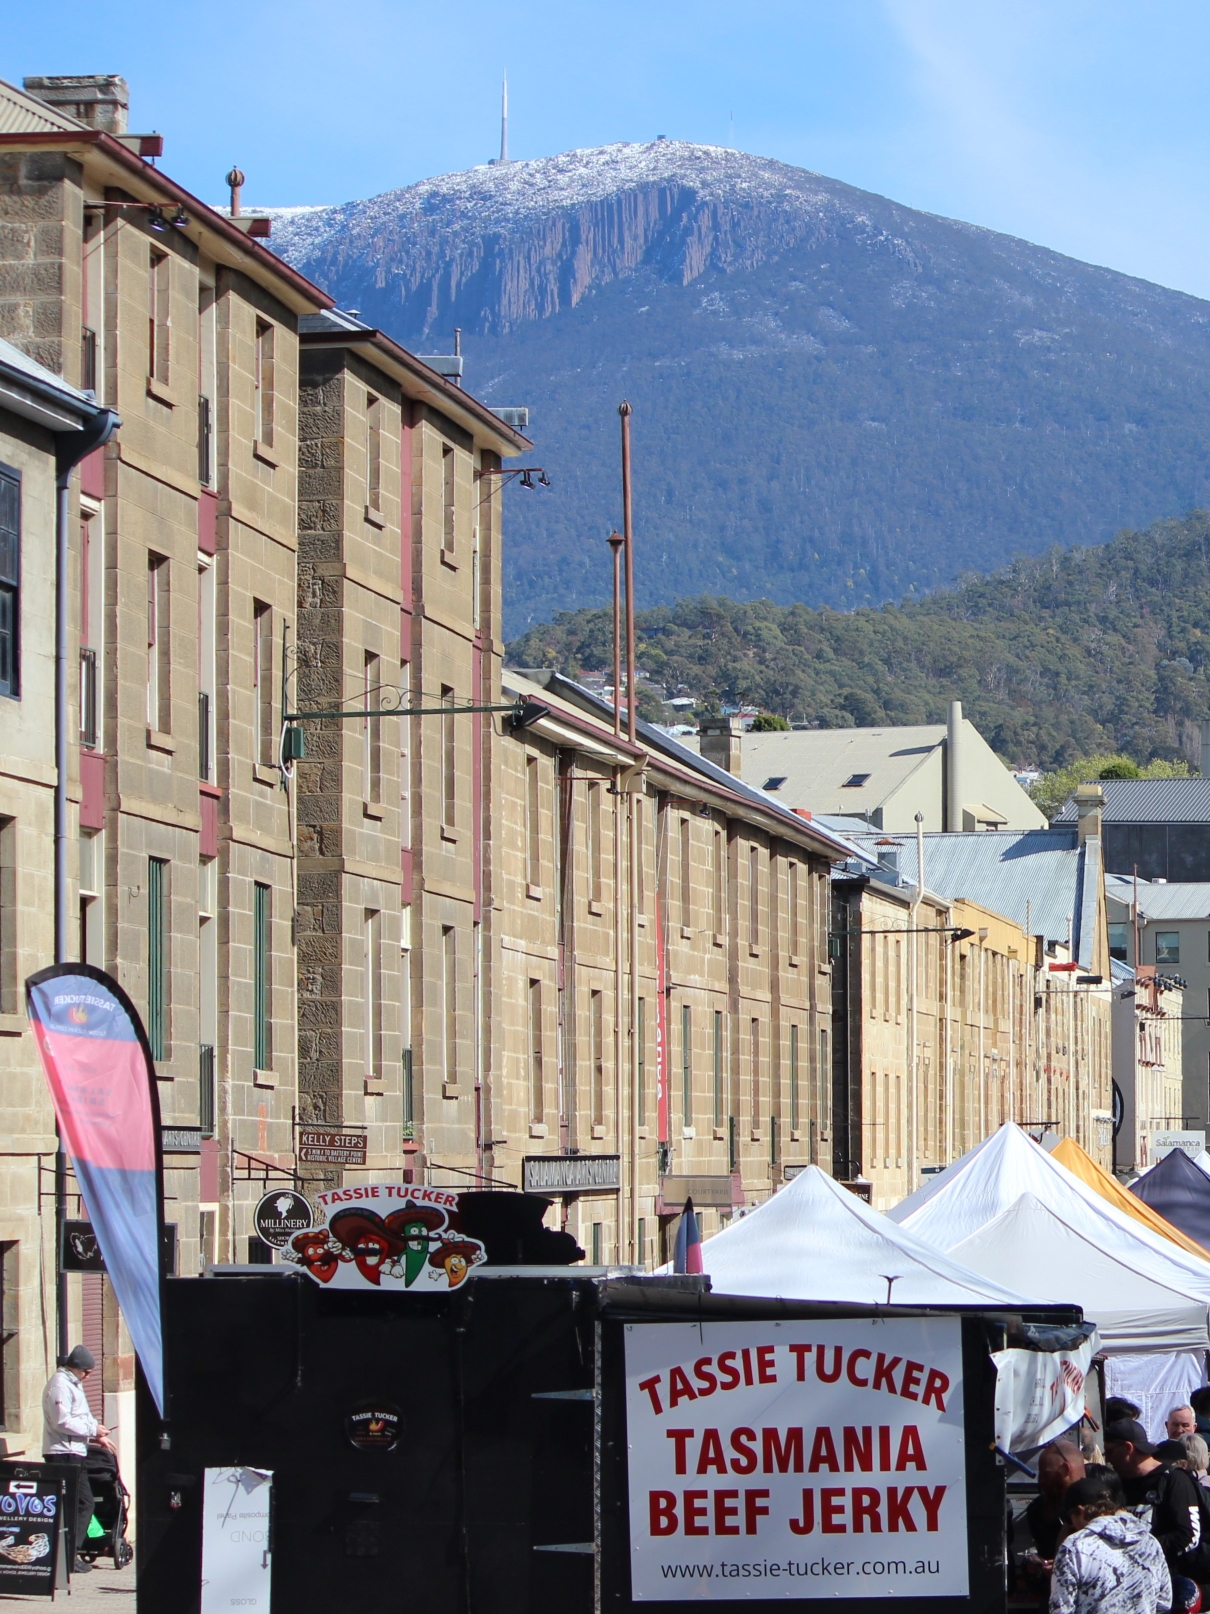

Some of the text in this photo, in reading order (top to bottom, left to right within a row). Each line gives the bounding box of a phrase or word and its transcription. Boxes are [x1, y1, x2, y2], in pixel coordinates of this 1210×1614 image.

[302, 1134, 364, 1147] KELLY STEPS
[1156, 1136, 1201, 1147] Salamanca
[318, 1186, 456, 1207] TASSIE TUCKER
[260, 1219, 308, 1228] MILLINERY
[638, 1343, 950, 1415] TASSIE TUCKER
[351, 1412, 398, 1422] TASSIE TUCKER
[666, 1425, 928, 1475] TASMANIA
[648, 1485, 947, 1536] BEEF JERKY
[661, 1557, 940, 1578] www.tassie-tucker.com.au
[230, 1598, 257, 1606] GLOSS
